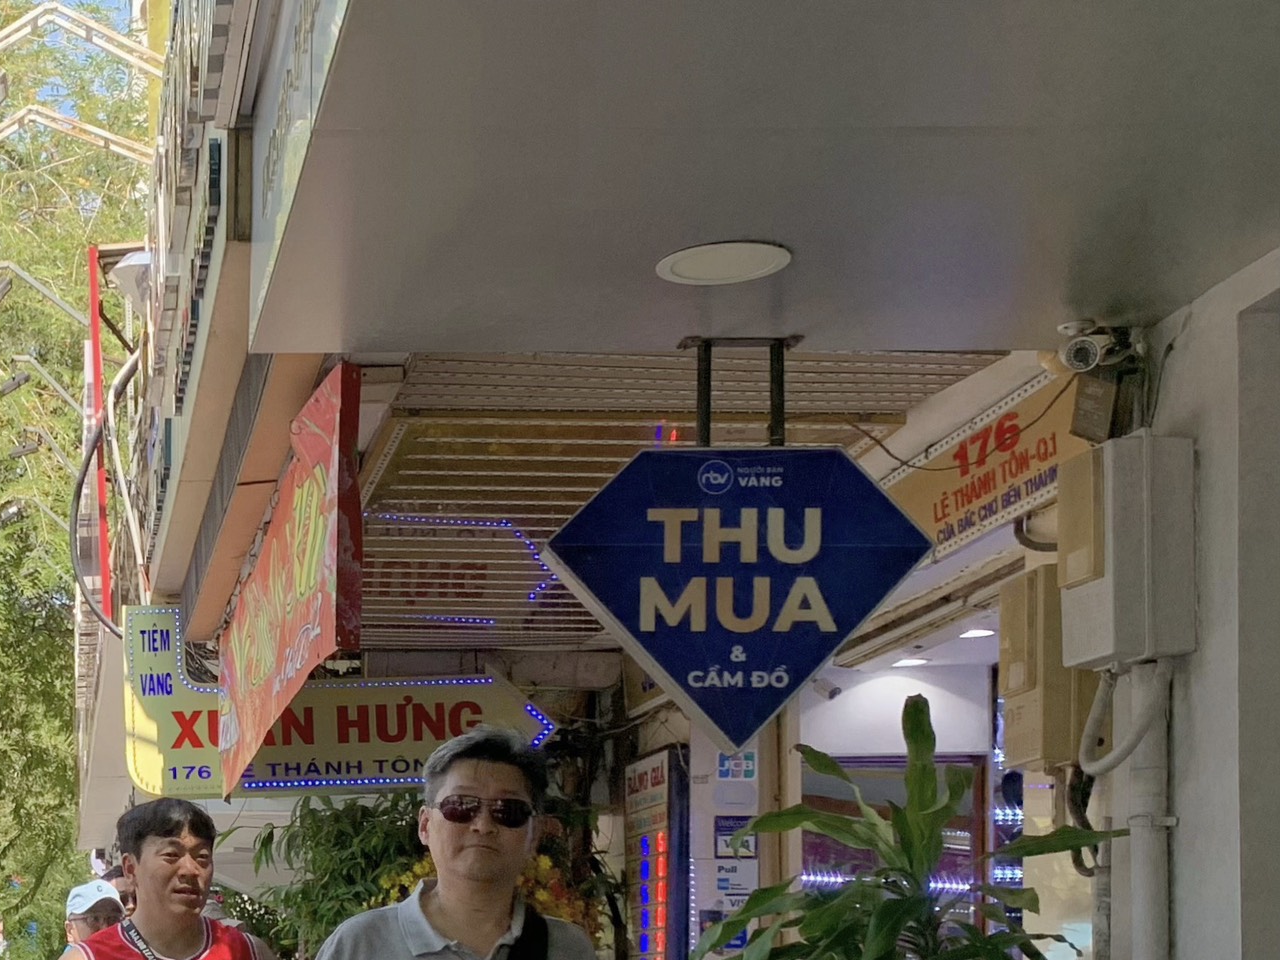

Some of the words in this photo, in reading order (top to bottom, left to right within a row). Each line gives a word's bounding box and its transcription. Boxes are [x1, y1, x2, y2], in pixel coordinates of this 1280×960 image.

[953, 412, 1021, 478] 176
[933, 491, 951, 524] LÊ
[951, 467, 998, 512] THÁNH
[646, 507, 823, 565] THU
[639, 576, 839, 633] MUA
[140, 622, 171, 657] TIỆM
[729, 645, 747, 662] &
[140, 666, 173, 697] VÀNG
[687, 664, 744, 688] CẦM
[750, 664, 790, 688] ĐỒ
[336, 695, 483, 744] HƯNG
[168, 765, 212, 781] 176
[269, 757, 363, 777] THÁNH
[718, 759, 754, 772] JCB
[717, 865, 738, 874] Pull
